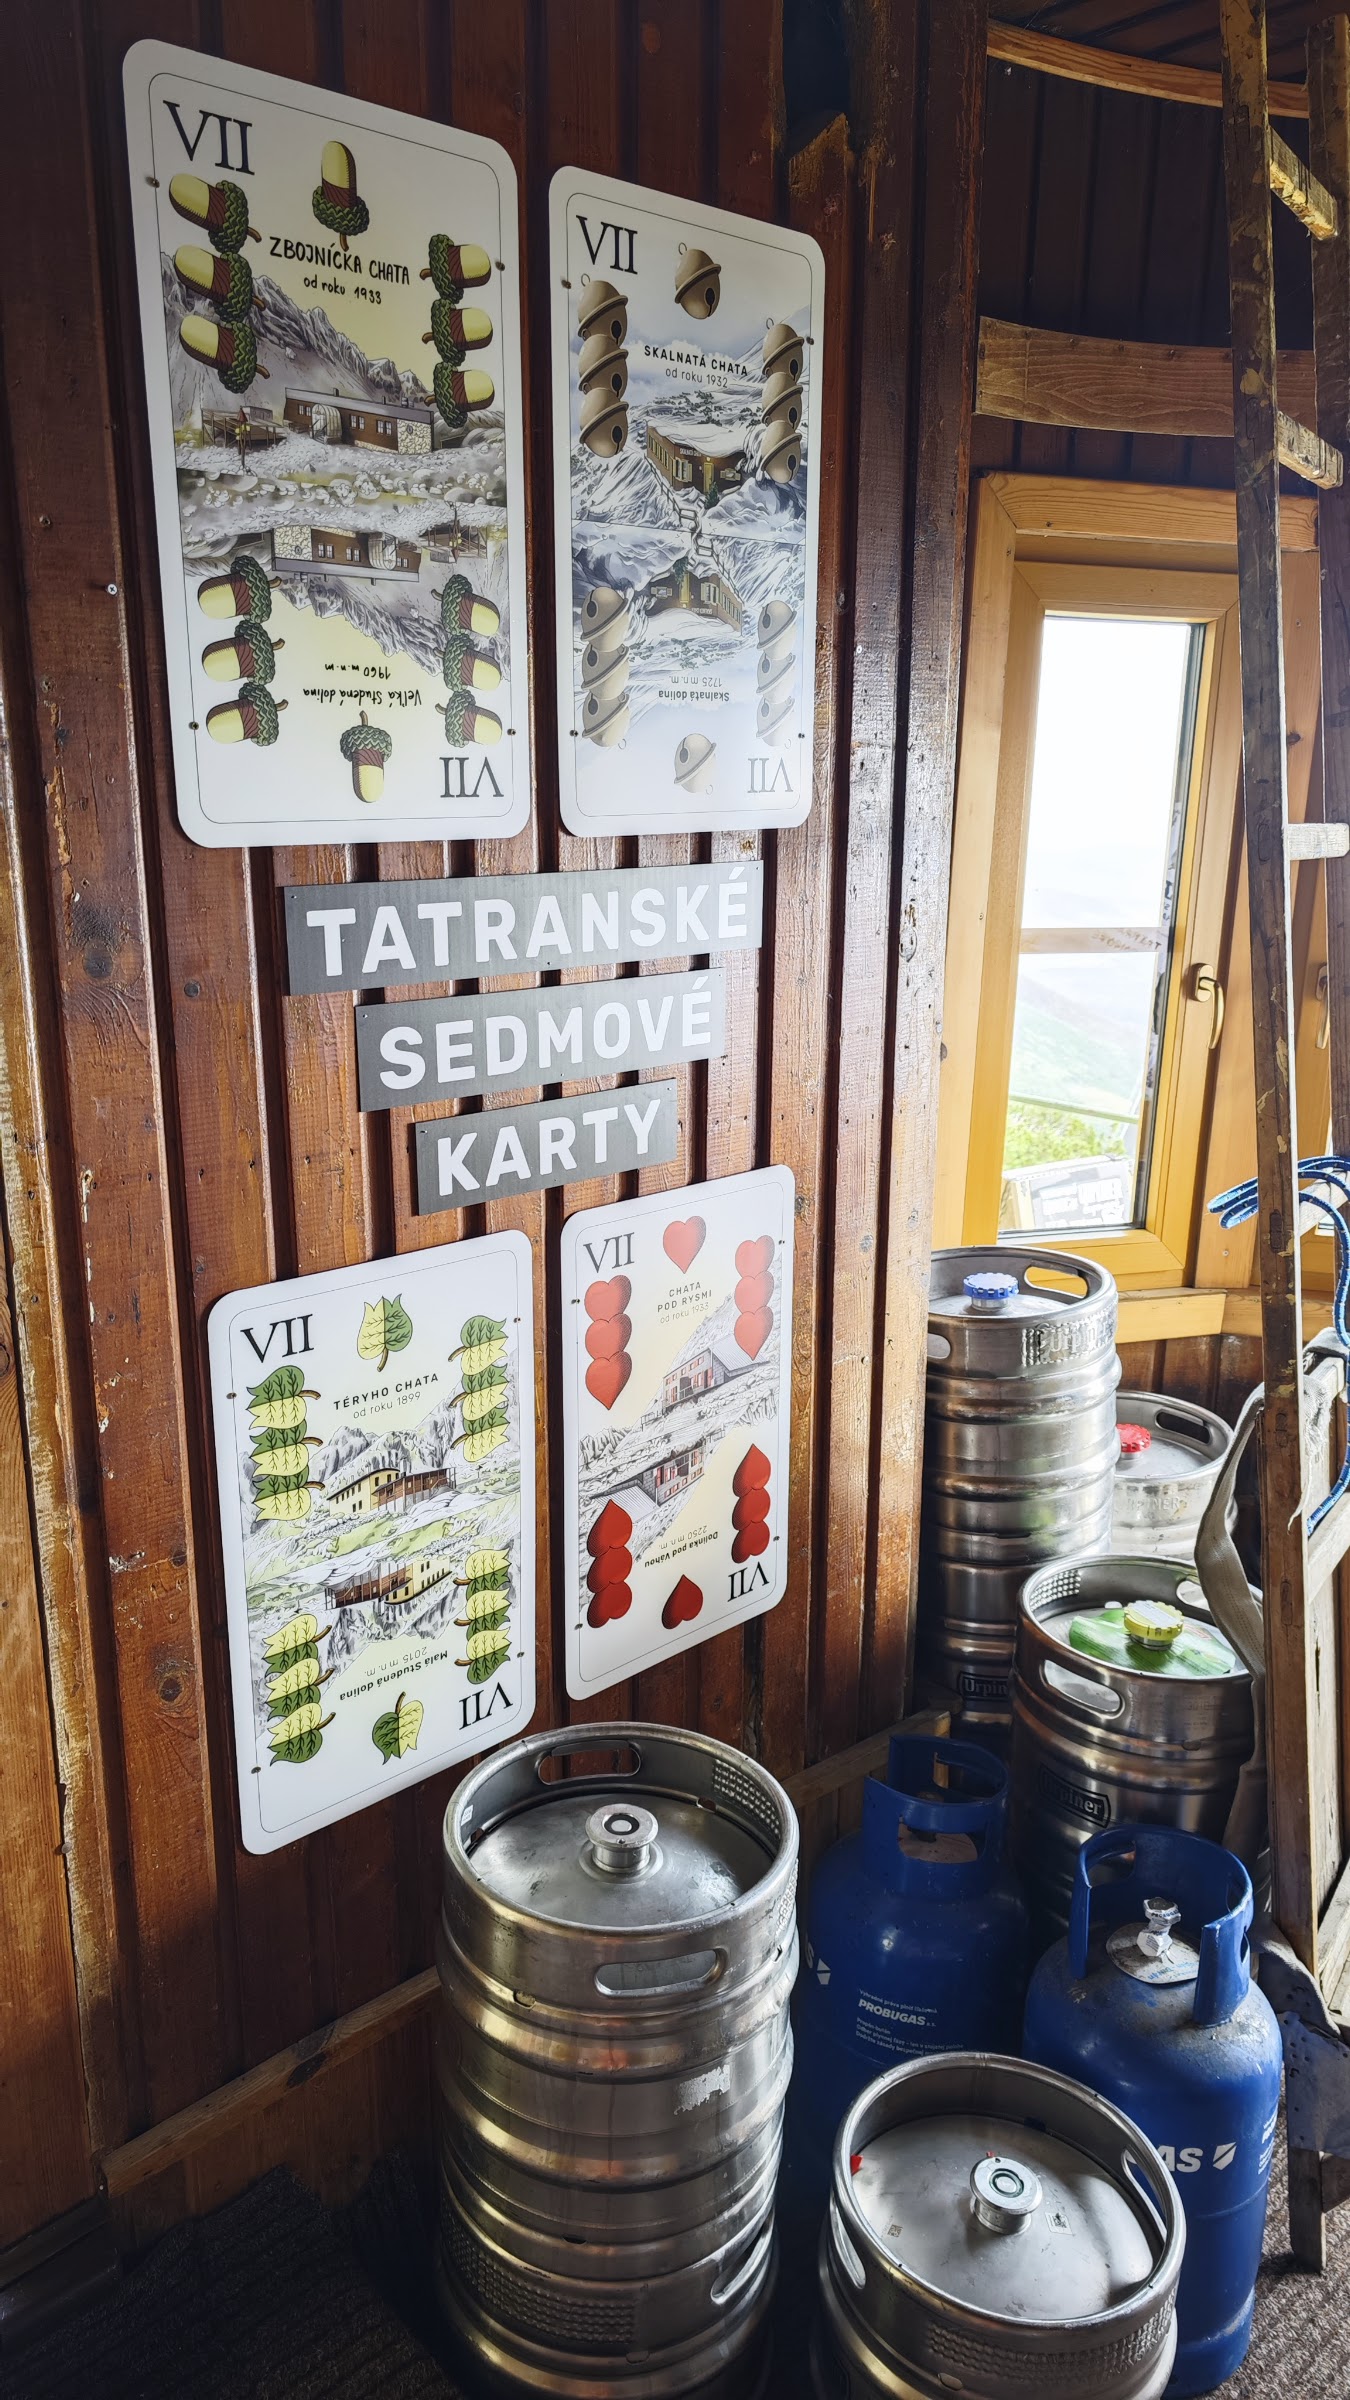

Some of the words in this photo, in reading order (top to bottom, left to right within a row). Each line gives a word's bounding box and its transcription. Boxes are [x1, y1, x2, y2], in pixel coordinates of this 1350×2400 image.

[163, 100, 255, 176] VII
[576, 215, 638, 275] VII
[269, 236, 362, 274] ZBOJNÍCKA
[369, 260, 410, 285] CHATA
[303, 274, 318, 289] od
[322, 277, 346, 295] roku
[354, 286, 382, 304] 1933
[644, 345, 706, 368] SKALNATÁ
[711, 359, 748, 376] CHATA
[665, 368, 678, 379] od
[681, 371, 703, 383] roku
[706, 374, 728, 388] 1932
[363, 666, 391, 680] 1960
[702, 677, 722, 687] 1725
[303, 688, 336, 704] dolina
[339, 688, 383, 707] Studená
[388, 689, 422, 708] Veľká
[658, 690, 688, 701] dolina
[690, 690, 730, 702] Skalnatá
[439, 757, 504, 798] VII
[747, 757, 794, 793] VII
[306, 866, 748, 977] TATRANSKÉ
[379, 975, 712, 1090] SEDMOVÉ
[437, 1099, 661, 1196] KARTY
[583, 1232, 635, 1274] VII
[657, 1300, 678, 1313] POD
[681, 1289, 712, 1306] RYSMI
[669, 1281, 701, 1298] CHATA
[660, 1313, 670, 1324] od
[672, 1309, 689, 1320] roku
[240, 1313, 315, 1363] VII
[333, 1387, 389, 1410] TÉRYHO
[395, 1373, 438, 1393] CHATA
[353, 1407, 366, 1419] od
[370, 1401, 393, 1414] roku
[397, 1391, 421, 1406] 1899
[687, 1525, 708, 1540] 2250
[689, 1531, 718, 1548] Dolinka
[644, 1552, 671, 1568] Váhou
[672, 1542, 687, 1557] pod
[727, 1561, 770, 1603] VII
[403, 1646, 428, 1664] 2015
[424, 1650, 448, 1668] Malá
[377, 1661, 422, 1687] Studená
[340, 1681, 374, 1701] dolina
[459, 1682, 513, 1730] VII
[858, 1998, 926, 2026] PROBUGAS
